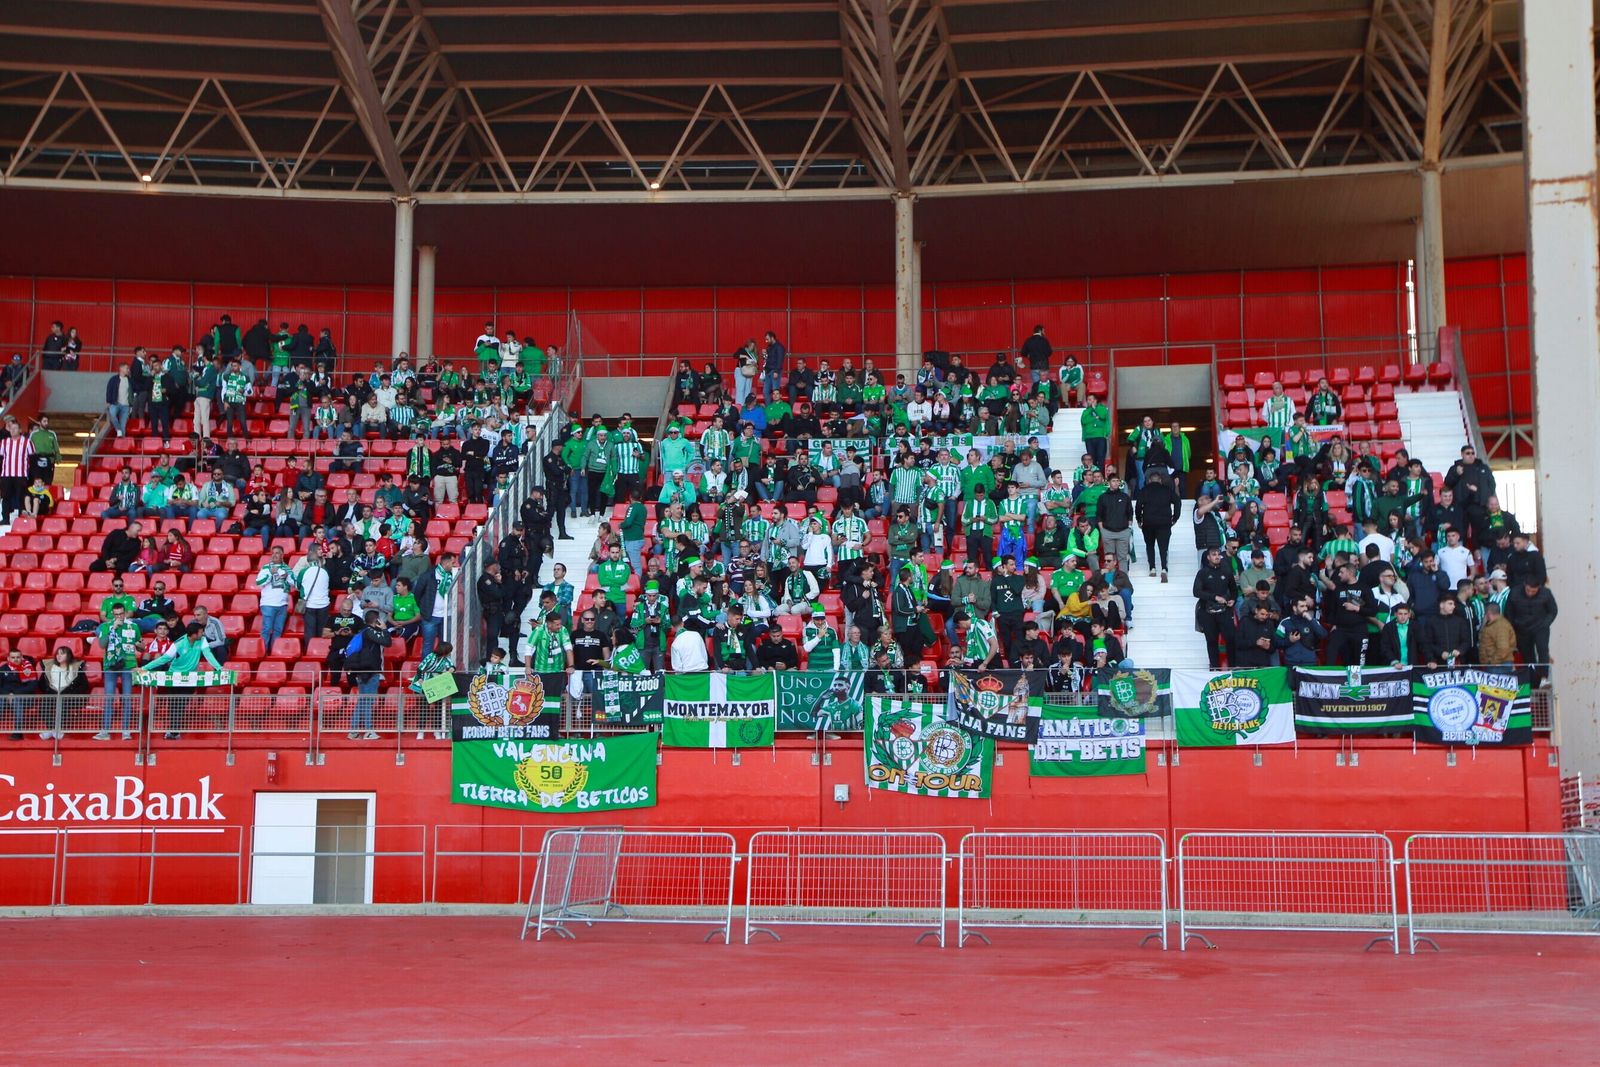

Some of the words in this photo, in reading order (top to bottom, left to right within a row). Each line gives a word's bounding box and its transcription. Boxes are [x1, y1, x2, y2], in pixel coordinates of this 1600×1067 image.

[812, 440, 866, 449] GLLENA
[618, 680, 634, 692] DEL
[635, 678, 660, 692] 2000
[1209, 678, 1259, 691] ALMONTE
[1422, 669, 1519, 691] BELLAVISTA
[1369, 679, 1410, 699] BETIS
[667, 702, 770, 717] MONTEMAYOR
[498, 725, 524, 738] BETIS
[526, 725, 550, 738] FANS
[985, 721, 1027, 739] FANS
[1212, 721, 1237, 731] BETIS
[1238, 719, 1260, 730] FANS
[1442, 730, 1473, 742] BETIS
[1476, 731, 1503, 742] FANS
[493, 742, 606, 763] VALENCINA
[1034, 740, 1073, 761] DEL
[1079, 738, 1141, 761] BETIS
[915, 771, 982, 792] TOUR
[460, 783, 528, 806] TIERRA
[539, 791, 565, 808] DE
[576, 786, 649, 808] BETICOS
